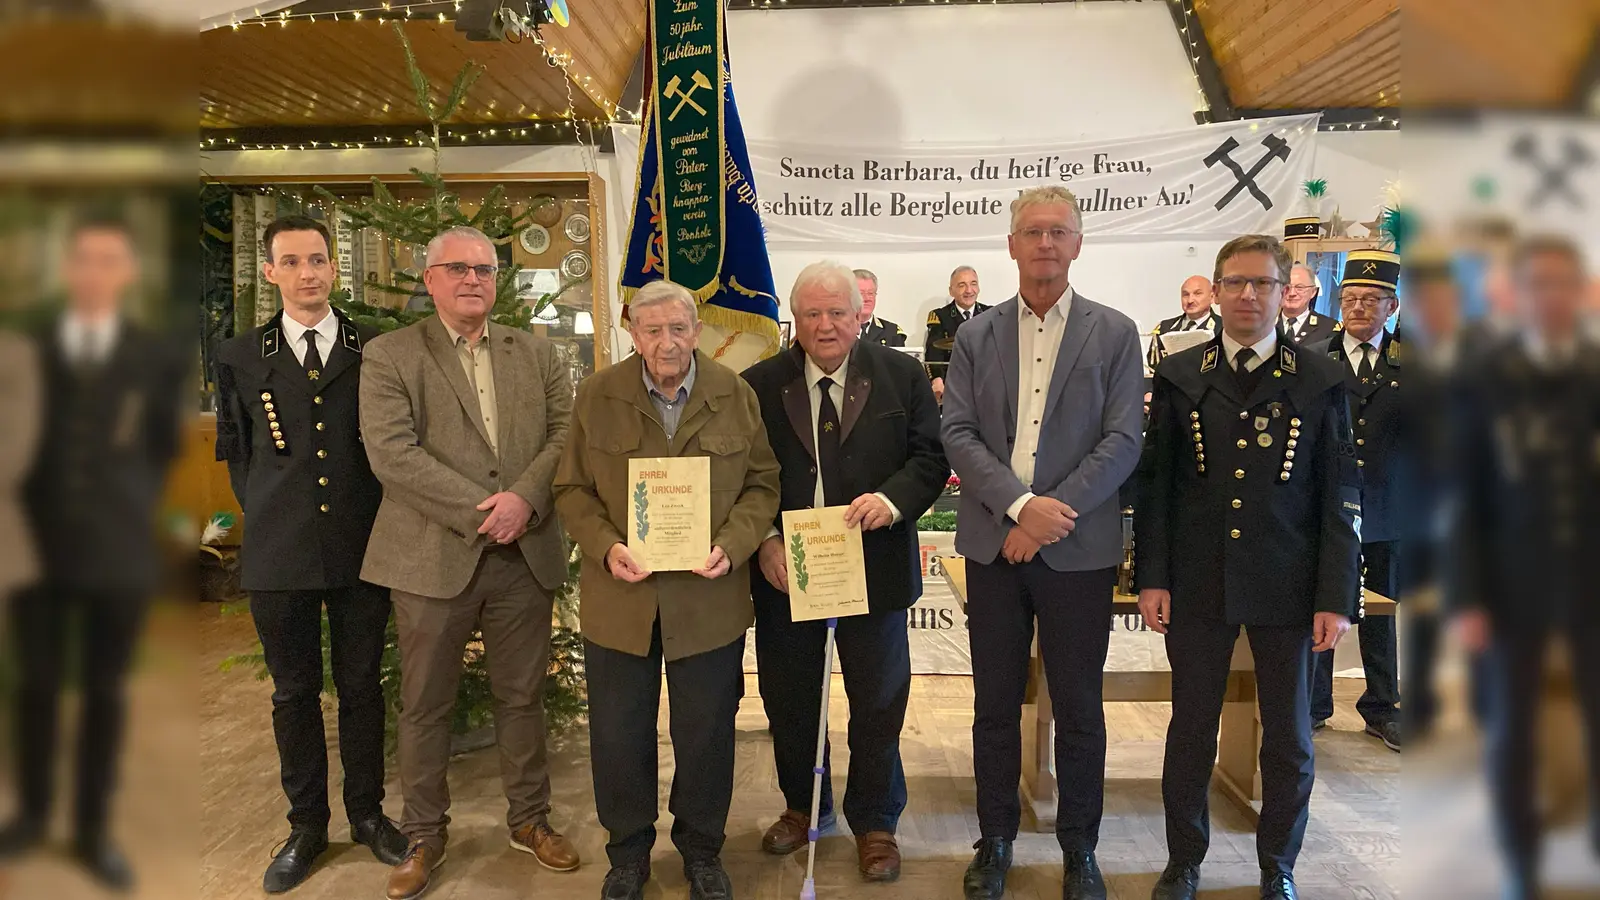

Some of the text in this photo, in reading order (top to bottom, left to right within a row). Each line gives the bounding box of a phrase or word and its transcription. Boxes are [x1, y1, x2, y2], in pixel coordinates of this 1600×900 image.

[669, 16, 704, 39] 50 jähr.
[662, 41, 713, 65] Jubiläum
[670, 126, 709, 150] gewidmet
[682, 147, 698, 156] vom
[675, 158, 709, 175] Paten-
[779, 156, 856, 181] Sancta
[863, 159, 963, 184] Barbara,
[970, 158, 1000, 181] du
[1093, 153, 1153, 175] Frau,
[679, 178, 707, 194] Berg-
[673, 195, 713, 210] knappen-
[840, 192, 883, 218] alle
[889, 191, 1003, 224] Bergleute
[1156, 183, 1195, 206] Au!
[683, 210, 706, 221] verein
[677, 223, 712, 242] Ponholz
[639, 471, 668, 480] EHREN
[651, 485, 693, 495] URKUNDE
[793, 521, 821, 532] EHREN
[807, 533, 846, 545] URKUNDE
